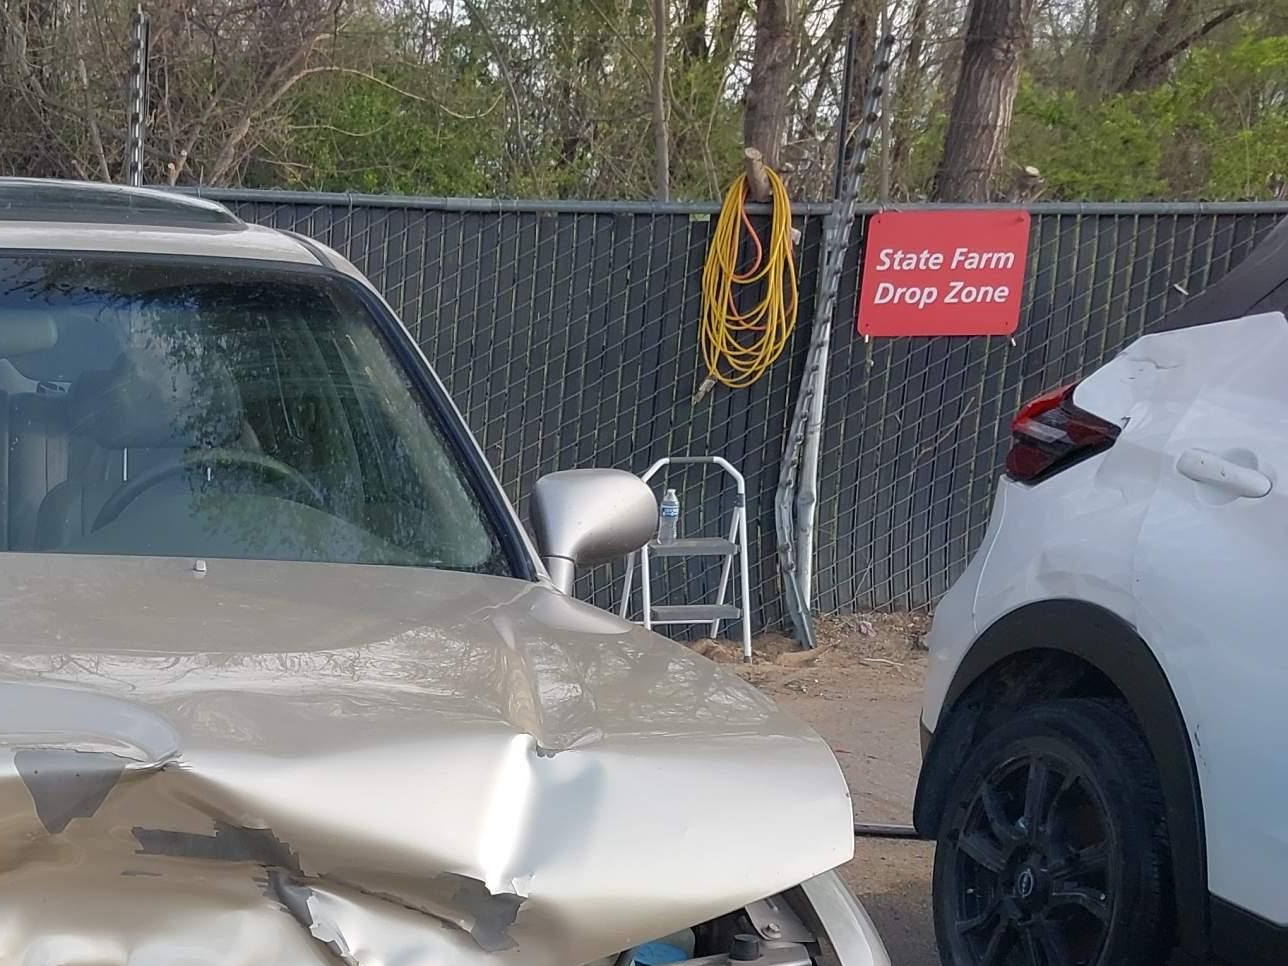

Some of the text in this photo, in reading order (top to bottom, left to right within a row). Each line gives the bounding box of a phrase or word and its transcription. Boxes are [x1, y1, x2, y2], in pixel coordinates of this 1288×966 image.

[876, 248, 1015, 271] State Farm
[874, 281, 1010, 309] Drop Zone
